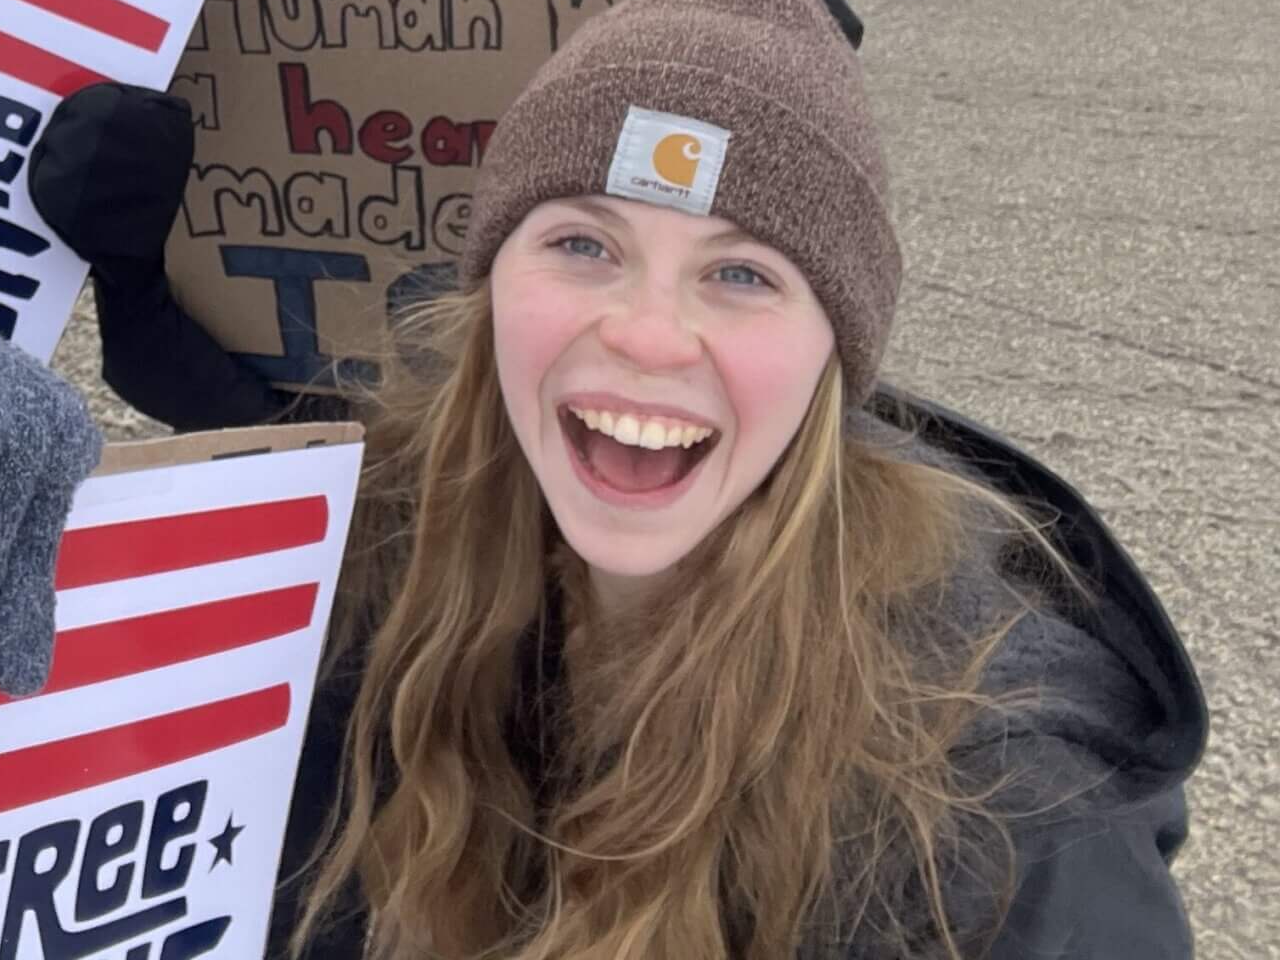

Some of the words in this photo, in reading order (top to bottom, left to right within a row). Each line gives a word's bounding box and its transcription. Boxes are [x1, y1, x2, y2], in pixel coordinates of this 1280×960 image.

[279, 63, 498, 168] hea
[183, 163, 473, 257] made
[630, 176, 691, 200] carhartt
